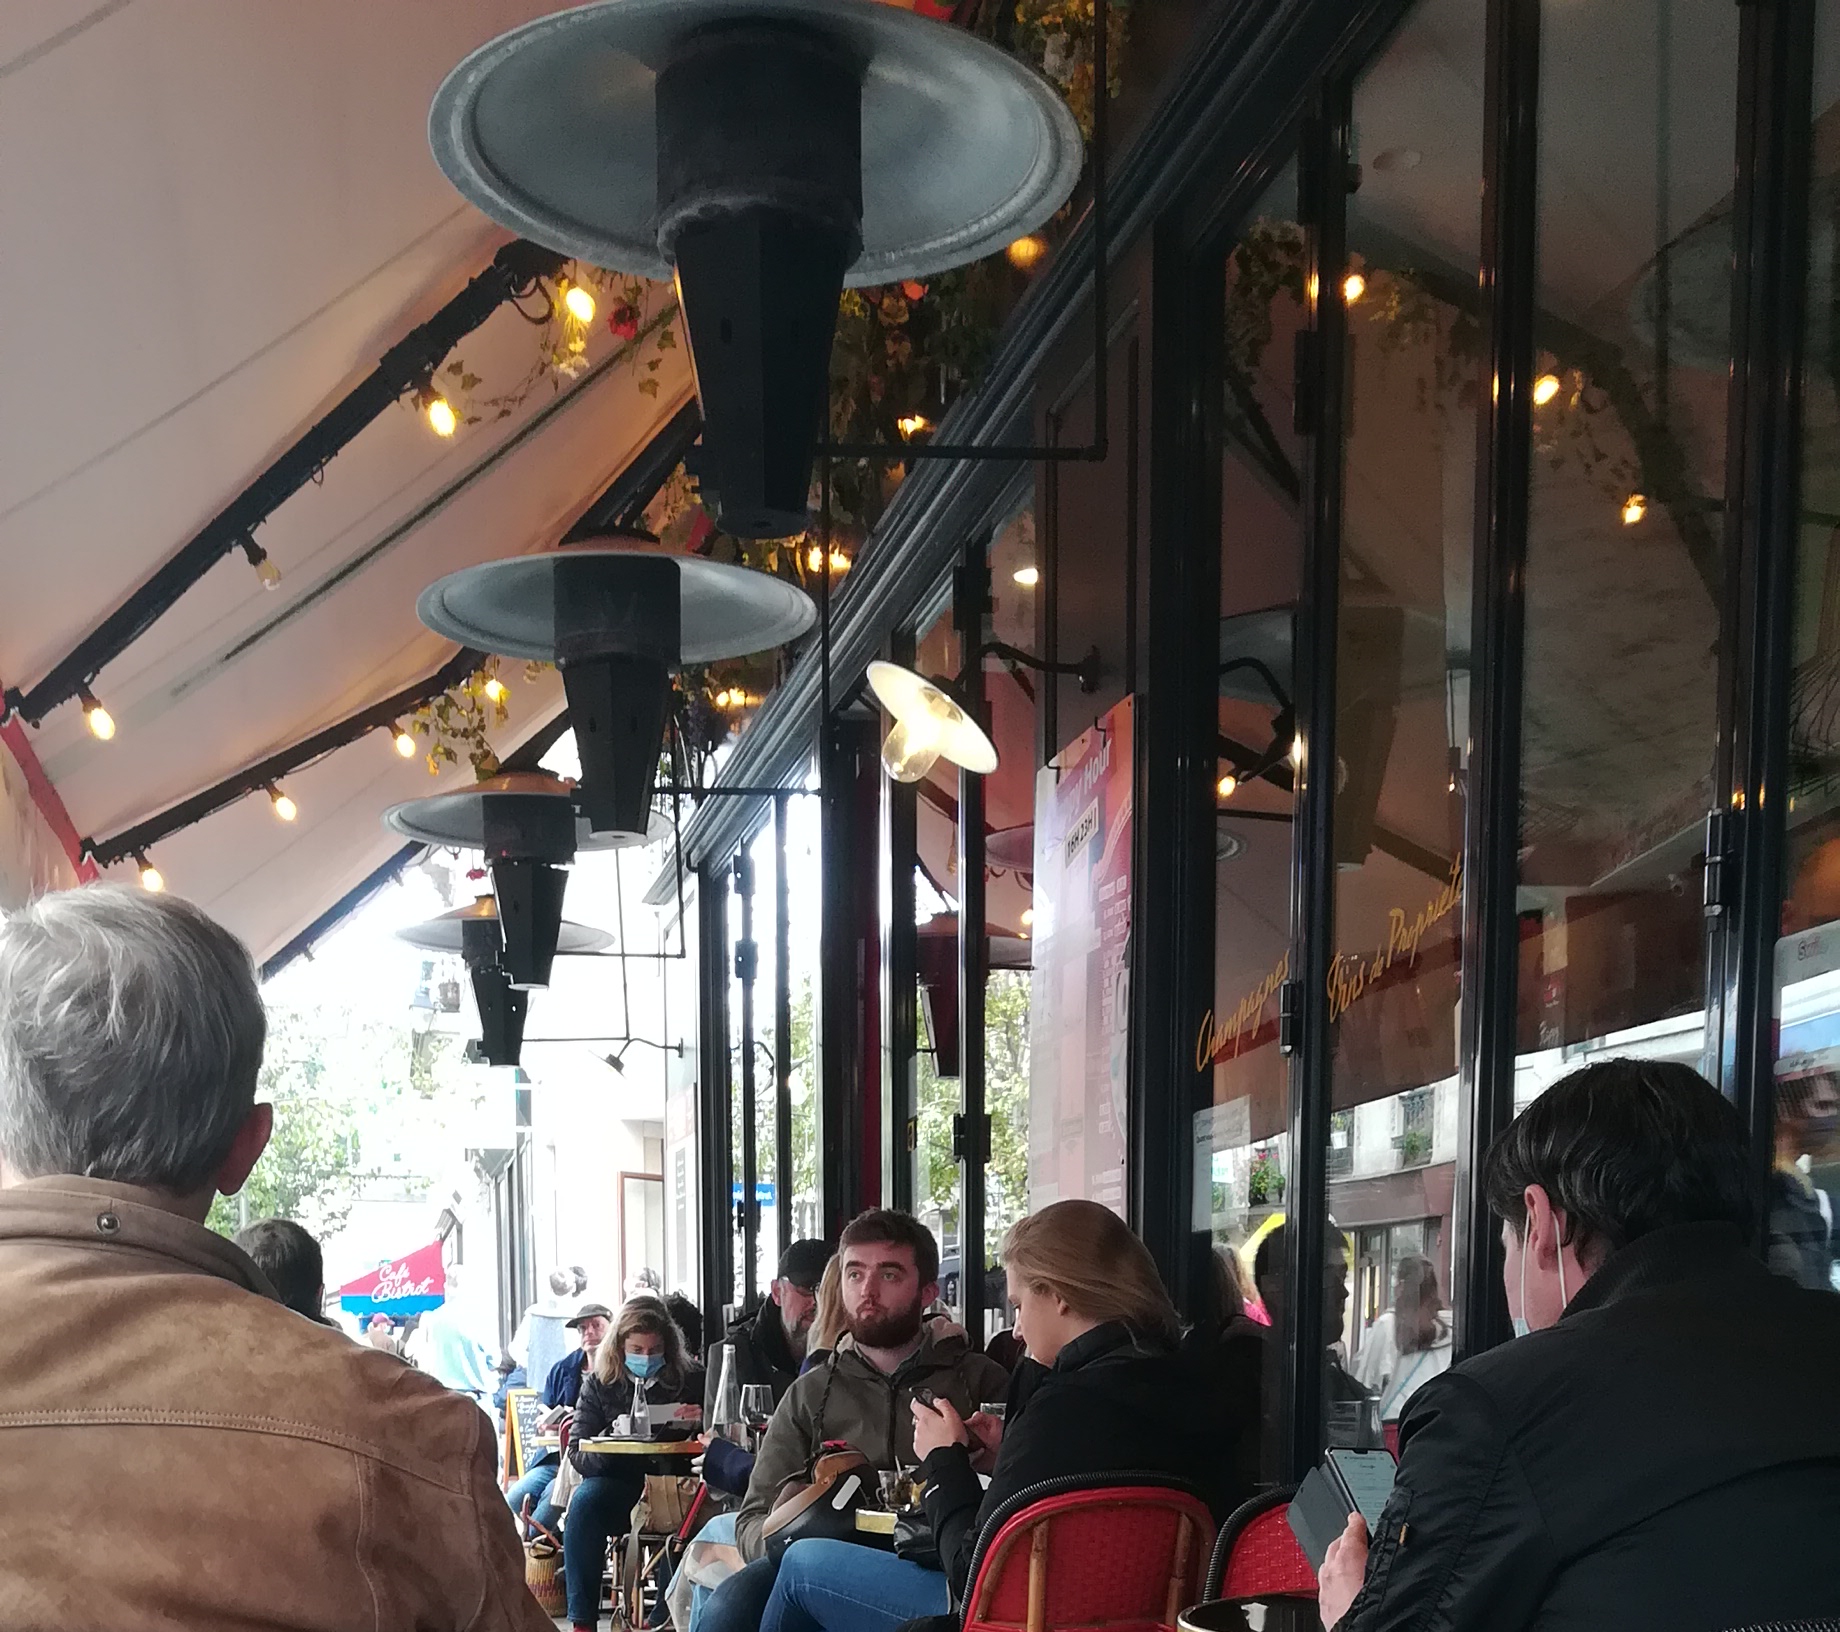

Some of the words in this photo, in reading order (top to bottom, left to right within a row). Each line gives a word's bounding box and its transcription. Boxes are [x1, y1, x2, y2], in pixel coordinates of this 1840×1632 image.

[1083, 738, 1112, 795] Hour
[1196, 948, 1290, 1073] Champagnes
[1326, 949, 1366, 1023] Vins
[1369, 943, 1384, 984] de
[371, 1276, 435, 1304] Bistrot
